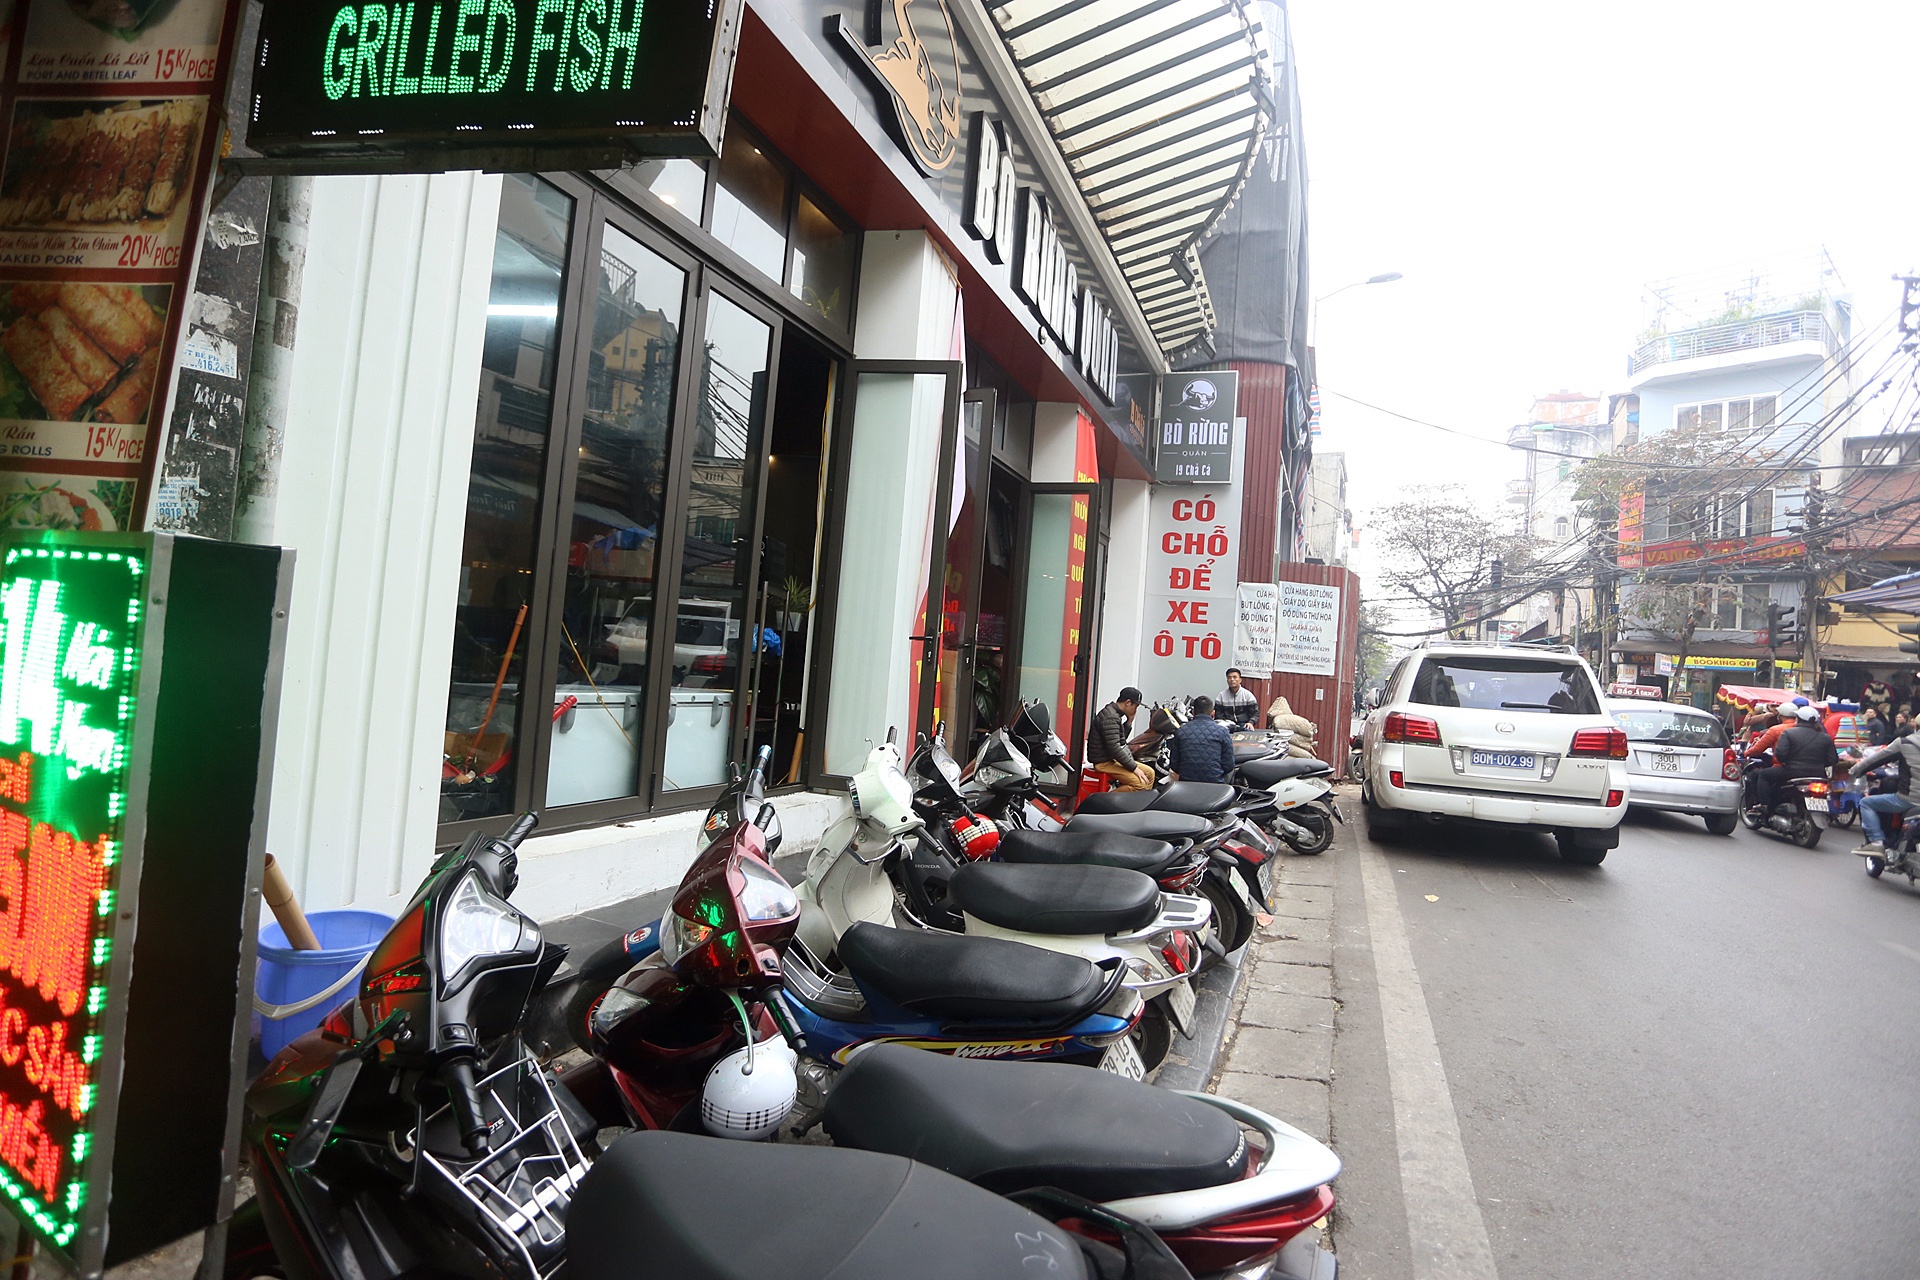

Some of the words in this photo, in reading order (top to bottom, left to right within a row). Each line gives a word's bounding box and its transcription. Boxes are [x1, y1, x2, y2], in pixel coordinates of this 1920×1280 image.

[322, 0, 518, 100] GRILLED
[525, 0, 645, 92] FISH
[56, 70, 80, 80] AND
[82, 70, 110, 80] BETEL
[112, 70, 137, 80] LEAF
[71, 236, 89, 251] Kim
[44, 254, 84, 265] PORK
[2, 426, 35, 440] Rán
[1163, 417, 1183, 445] BÒ
[1188, 417, 1229, 445] RỪNG
[11, 444, 52, 456] ROLLS
[1182, 449, 1207, 457] QUÁN
[1175, 464, 1184, 476] 19
[1185, 462, 1199, 476] Chả
[1201, 463, 1211, 476] Cá
[1172, 494, 1216, 522] CÓ
[1161, 525, 1229, 557] CHỖ
[1169, 558, 1216, 591] ĐỂ
[1295, 587, 1308, 596] HÀNG
[1309, 588, 1319, 597] BÚT
[1320, 589, 1333, 599] LÔNG
[1241, 599, 1252, 609] BÚT
[1166, 600, 1210, 625] XE
[1250, 637, 1257, 645] 21
[1291, 634, 1298, 642] 21
[1153, 629, 1174, 657] Ô
[1181, 632, 1222, 660] TÔ
[1693, 659, 1736, 667] BOOKING
[1691, 724, 1711, 733] taxi
[1472, 752, 1534, 768] 80M-002.99
[1657, 754, 1675, 763] 30U
[1654, 763, 1678, 771] 7528
